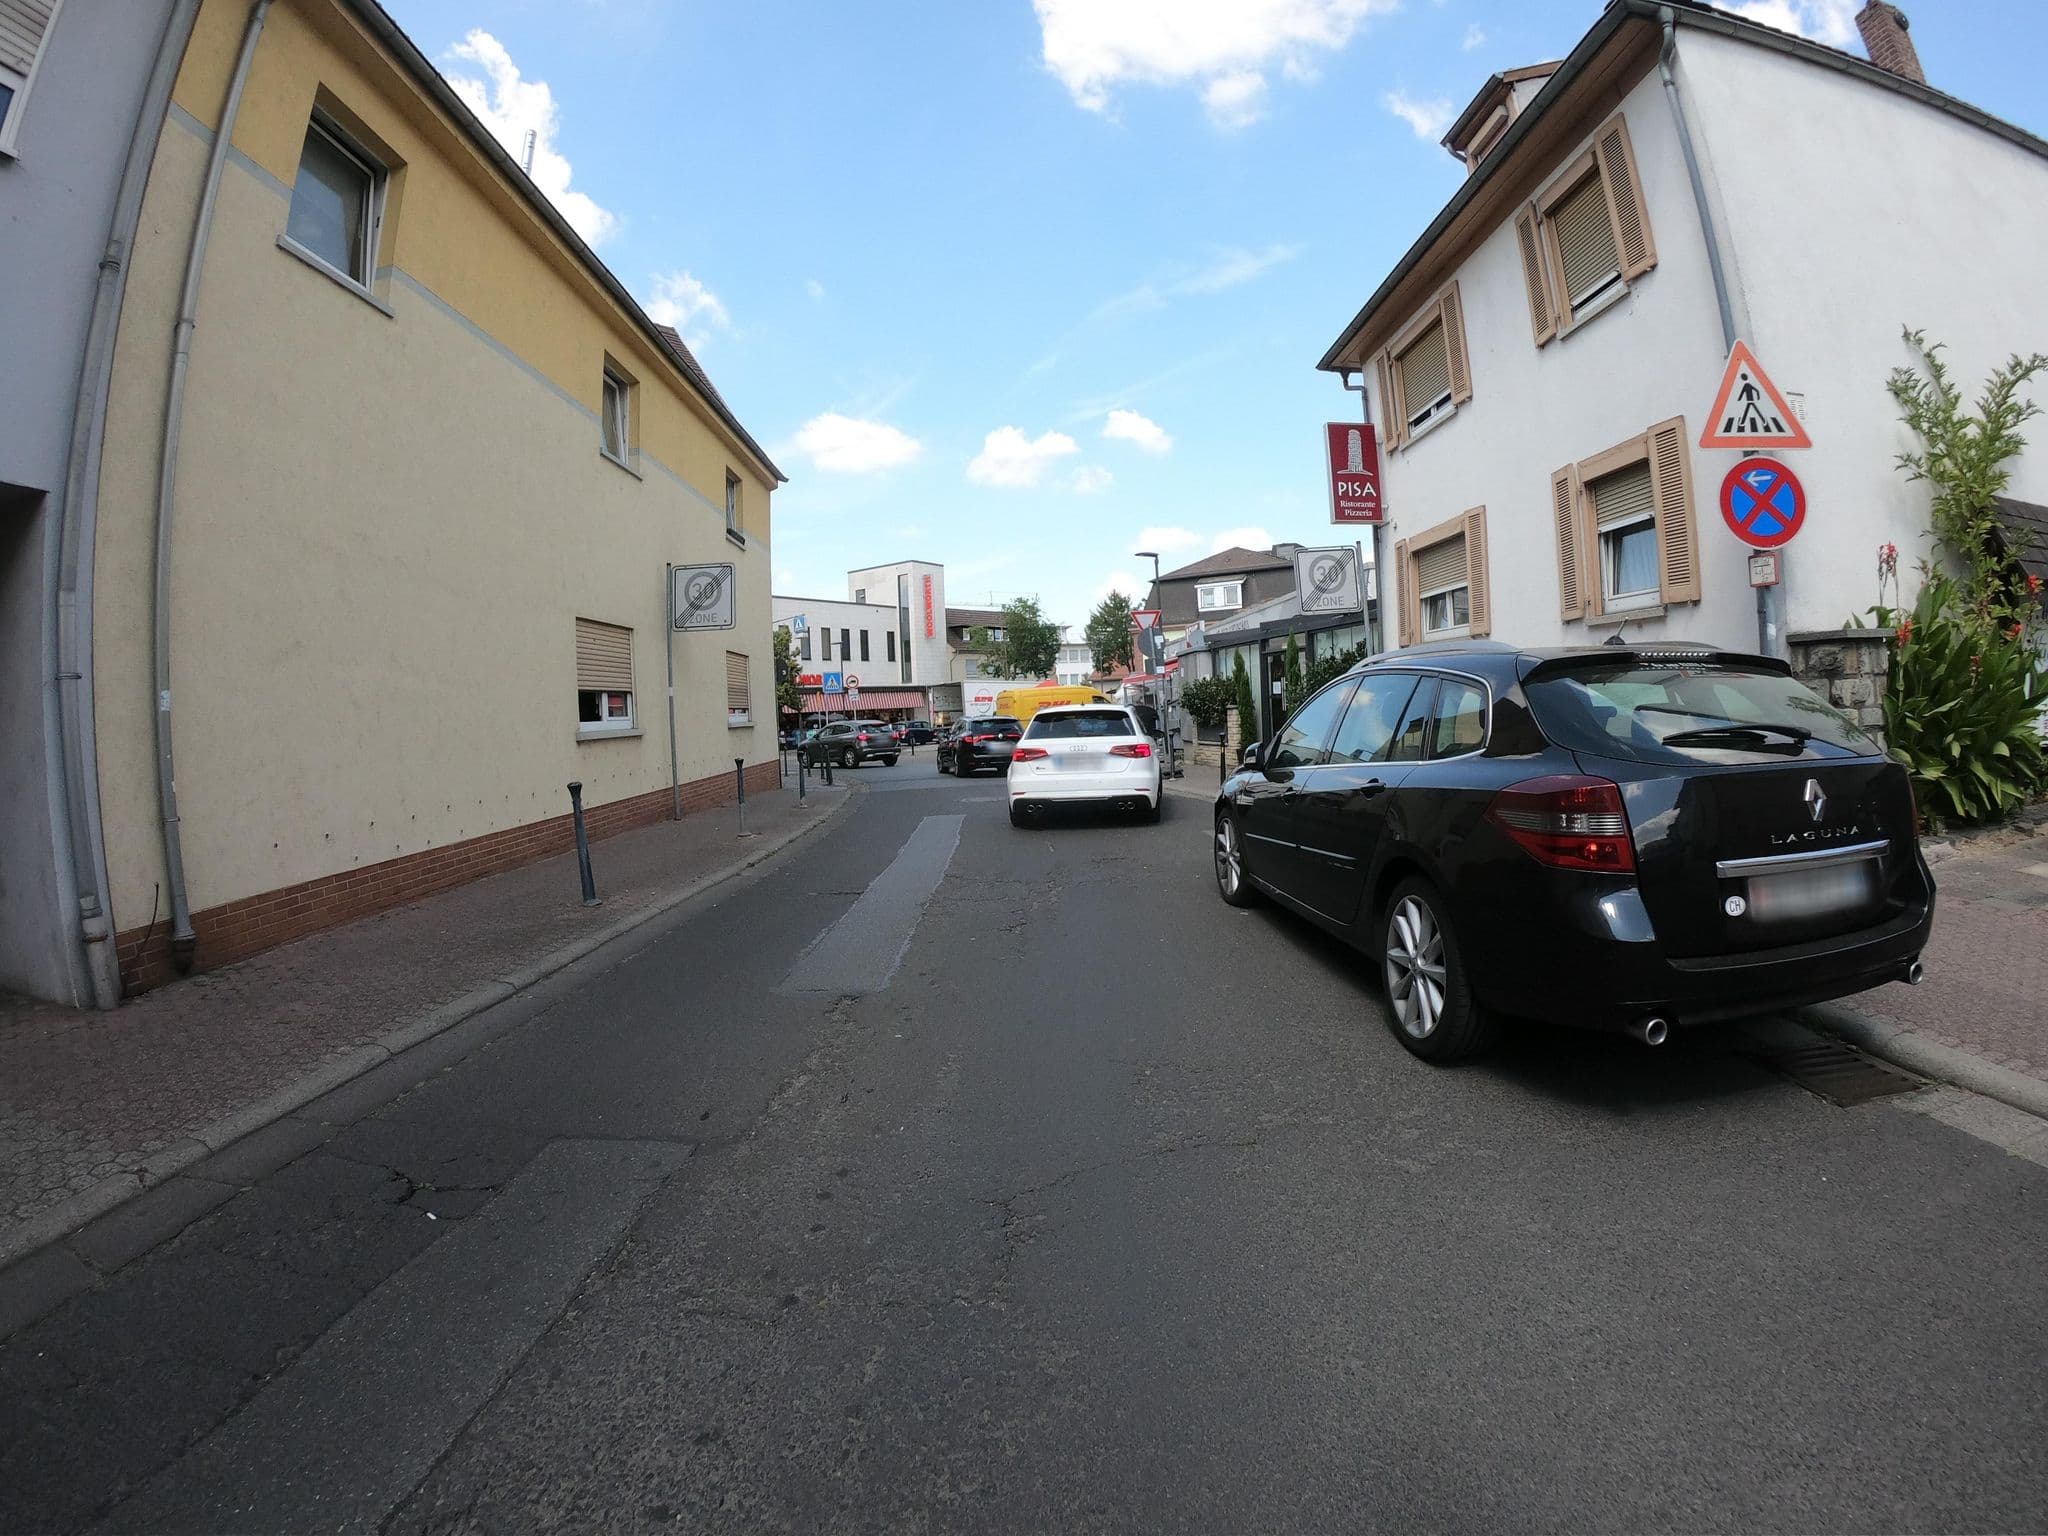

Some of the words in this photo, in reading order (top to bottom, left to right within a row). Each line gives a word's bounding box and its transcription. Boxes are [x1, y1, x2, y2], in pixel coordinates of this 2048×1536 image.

[1338, 481, 1377, 497] PISA
[1345, 509, 1373, 517] Pizzeria
[1316, 595, 1344, 608] ZONE
[689, 612, 718, 624] ZONE
[1771, 826, 1859, 844] LAGUNA
[1730, 900, 1740, 912] CH
